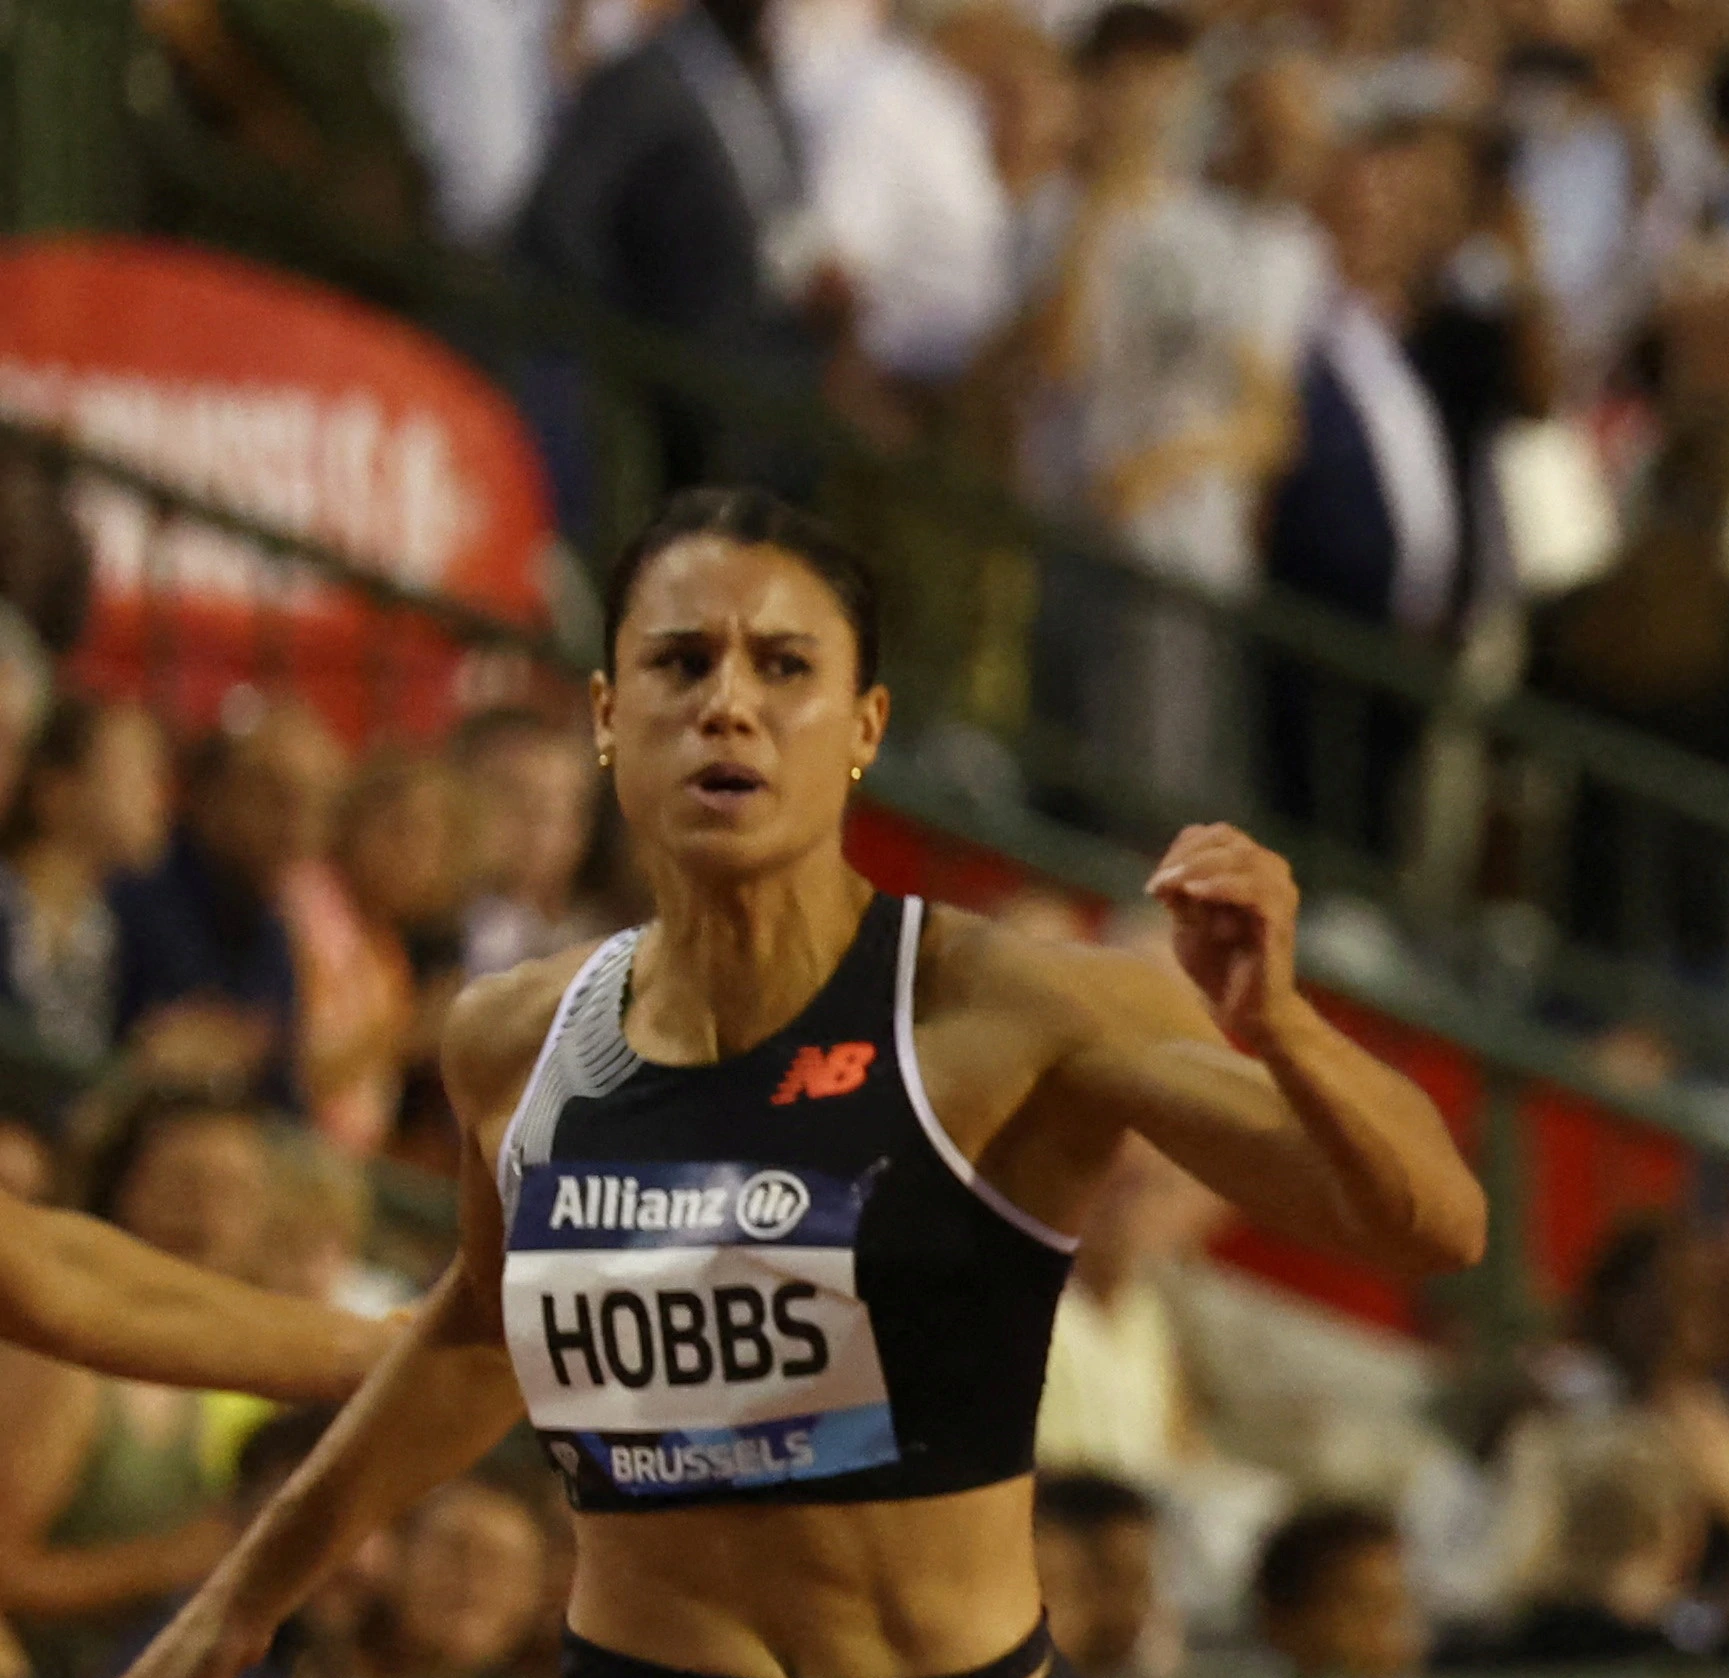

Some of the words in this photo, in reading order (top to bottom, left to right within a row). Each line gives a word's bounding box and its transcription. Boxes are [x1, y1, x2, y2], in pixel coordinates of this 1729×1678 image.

[769, 1041, 878, 1106] NB
[550, 1176, 728, 1231] Allianz
[542, 1282, 829, 1390] HOBBS
[610, 1429, 815, 1483] BRUSSELS
